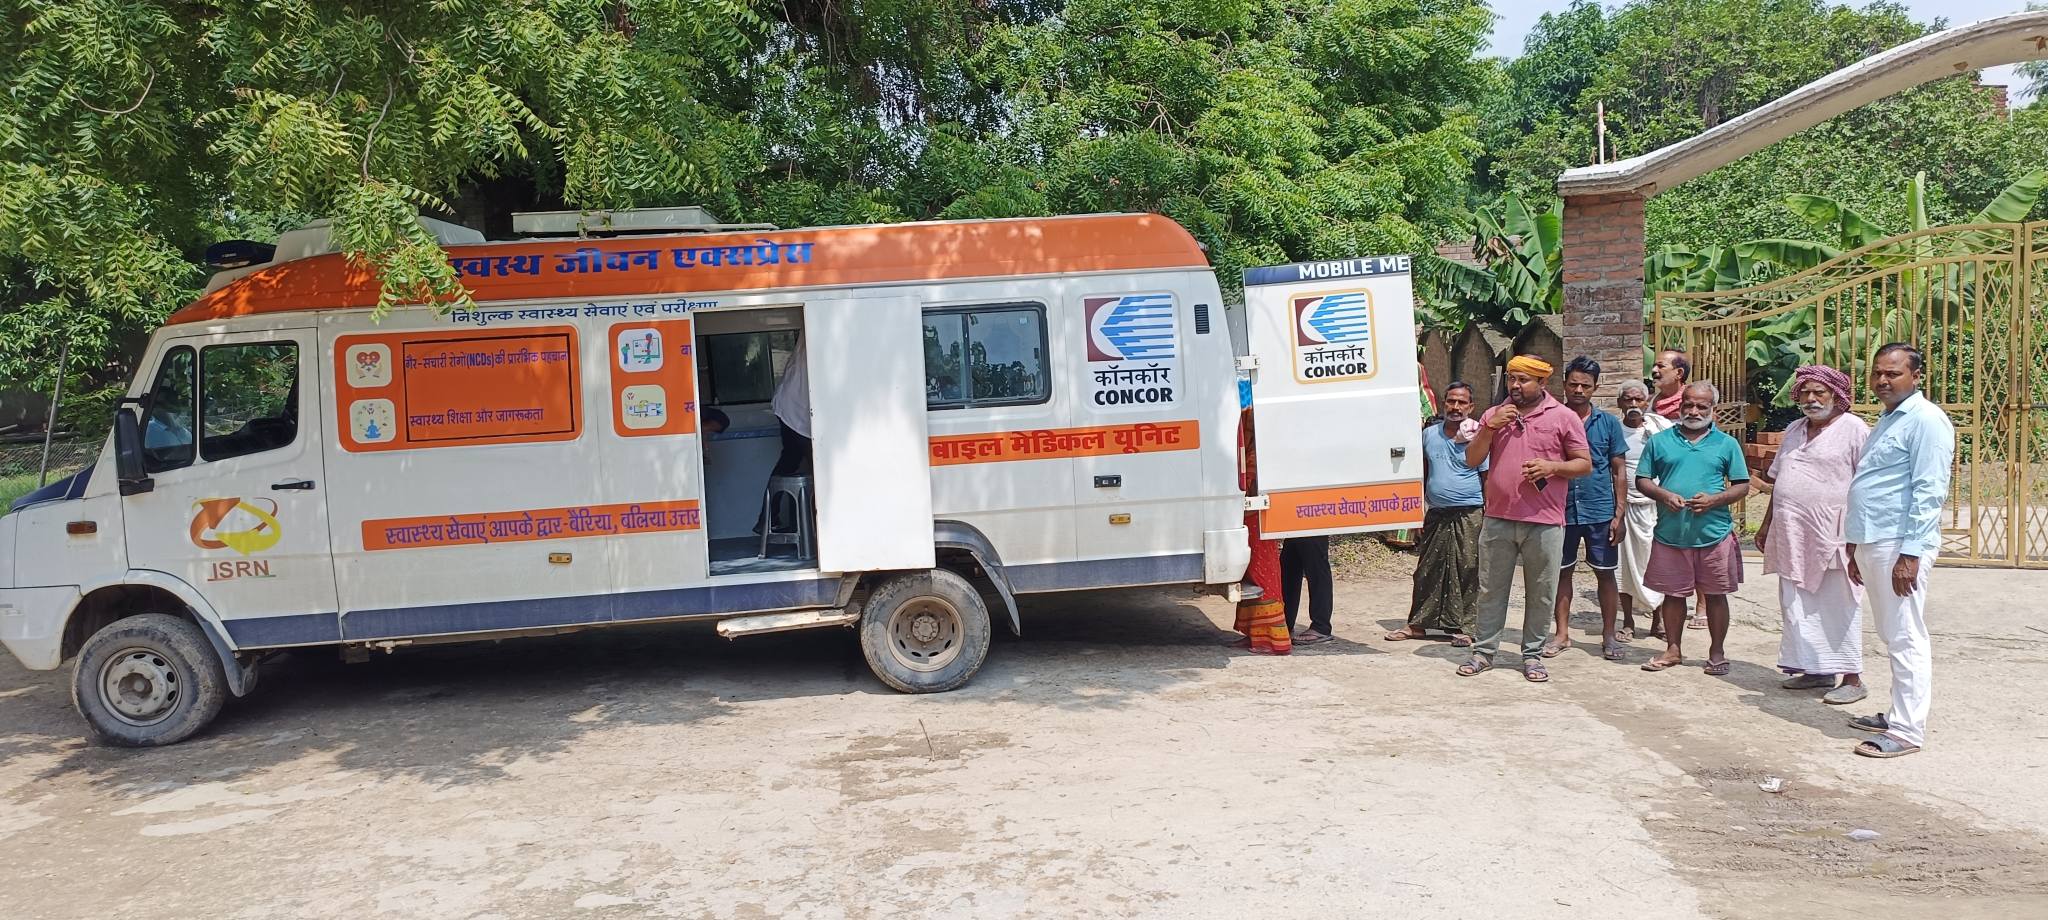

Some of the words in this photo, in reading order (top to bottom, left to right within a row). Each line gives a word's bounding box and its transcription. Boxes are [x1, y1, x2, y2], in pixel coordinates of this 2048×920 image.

[553, 247, 661, 273] जीवन
[671, 239, 815, 269] एक्सप्रेस
[1299, 259, 1373, 280] MOBILE
[1379, 256, 1409, 273] ME
[451, 308, 514, 327] निशुल्क
[518, 306, 579, 320] स्वास्थ्य
[583, 303, 628, 318] सेवाएं
[633, 301, 657, 316] एवं
[1304, 345, 1366, 364] कॉनकॉर
[1093, 363, 1172, 387] कॉनकॉर
[1304, 362, 1368, 379] CONCOR
[1094, 387, 1174, 406] CONCOR
[447, 408, 472, 425] शिक्षा
[1009, 430, 1107, 455] मेडिकल
[1113, 423, 1182, 454] यूनिट
[1296, 502, 1337, 519] स्वास्थ्य
[1338, 496, 1368, 518] सेवाएं
[1368, 493, 1400, 513] आपके
[1401, 496, 1421, 512] द्वार
[385, 524, 444, 545] स्वास्थ्य
[446, 515, 488, 544] सेवाएं
[489, 511, 534, 538] आपके
[620, 504, 667, 529] बलिया
[669, 508, 700, 526] उत्तर
[212, 559, 270, 579] ISRN
